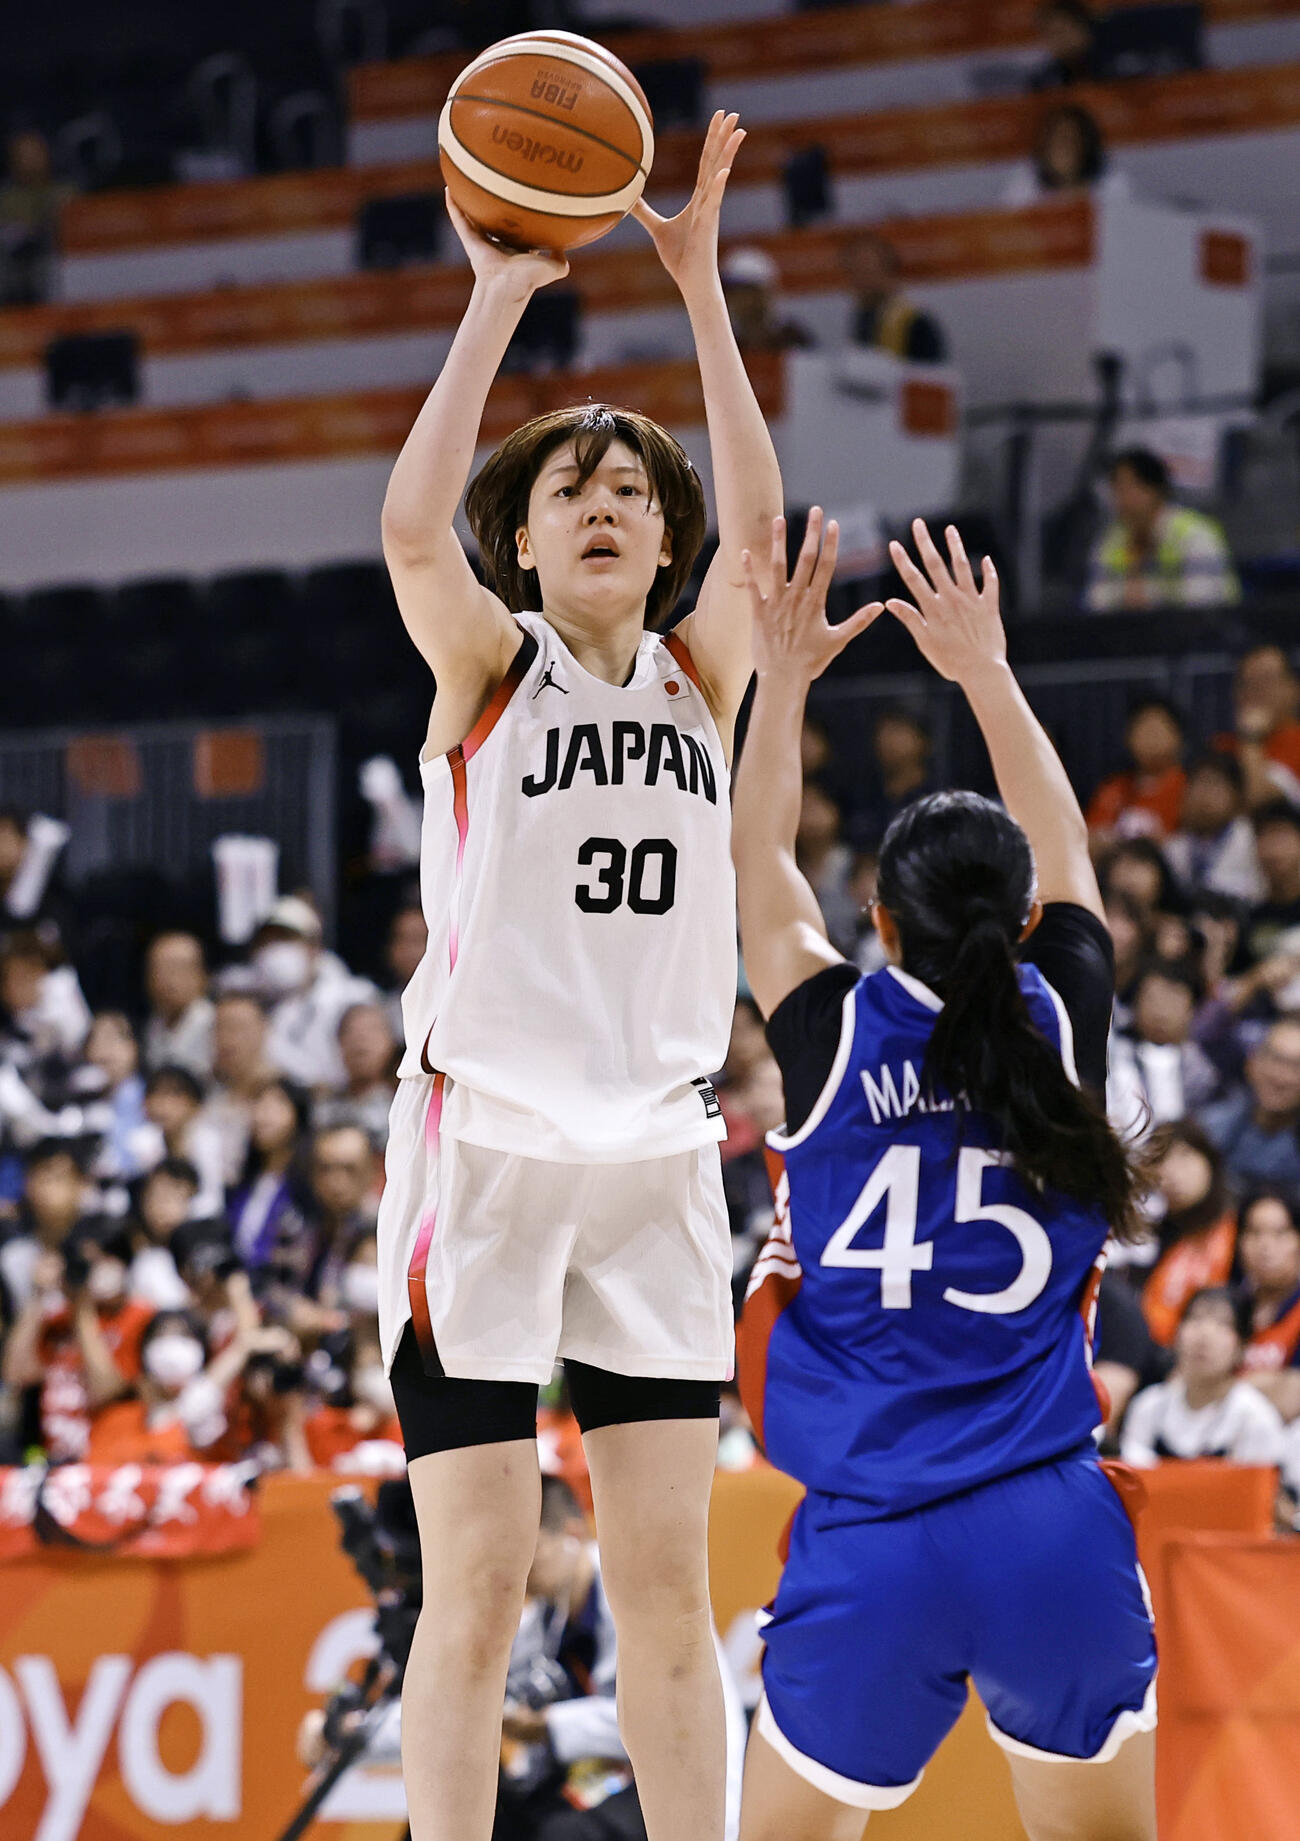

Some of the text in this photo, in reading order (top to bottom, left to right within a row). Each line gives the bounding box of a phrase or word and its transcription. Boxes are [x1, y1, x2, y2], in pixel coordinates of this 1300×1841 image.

[530, 79, 578, 111] FIBA
[491, 125, 585, 174] molten
[521, 721, 717, 806] JAPAN
[574, 837, 678, 915] 30
[819, 1144, 1053, 1315] 45
